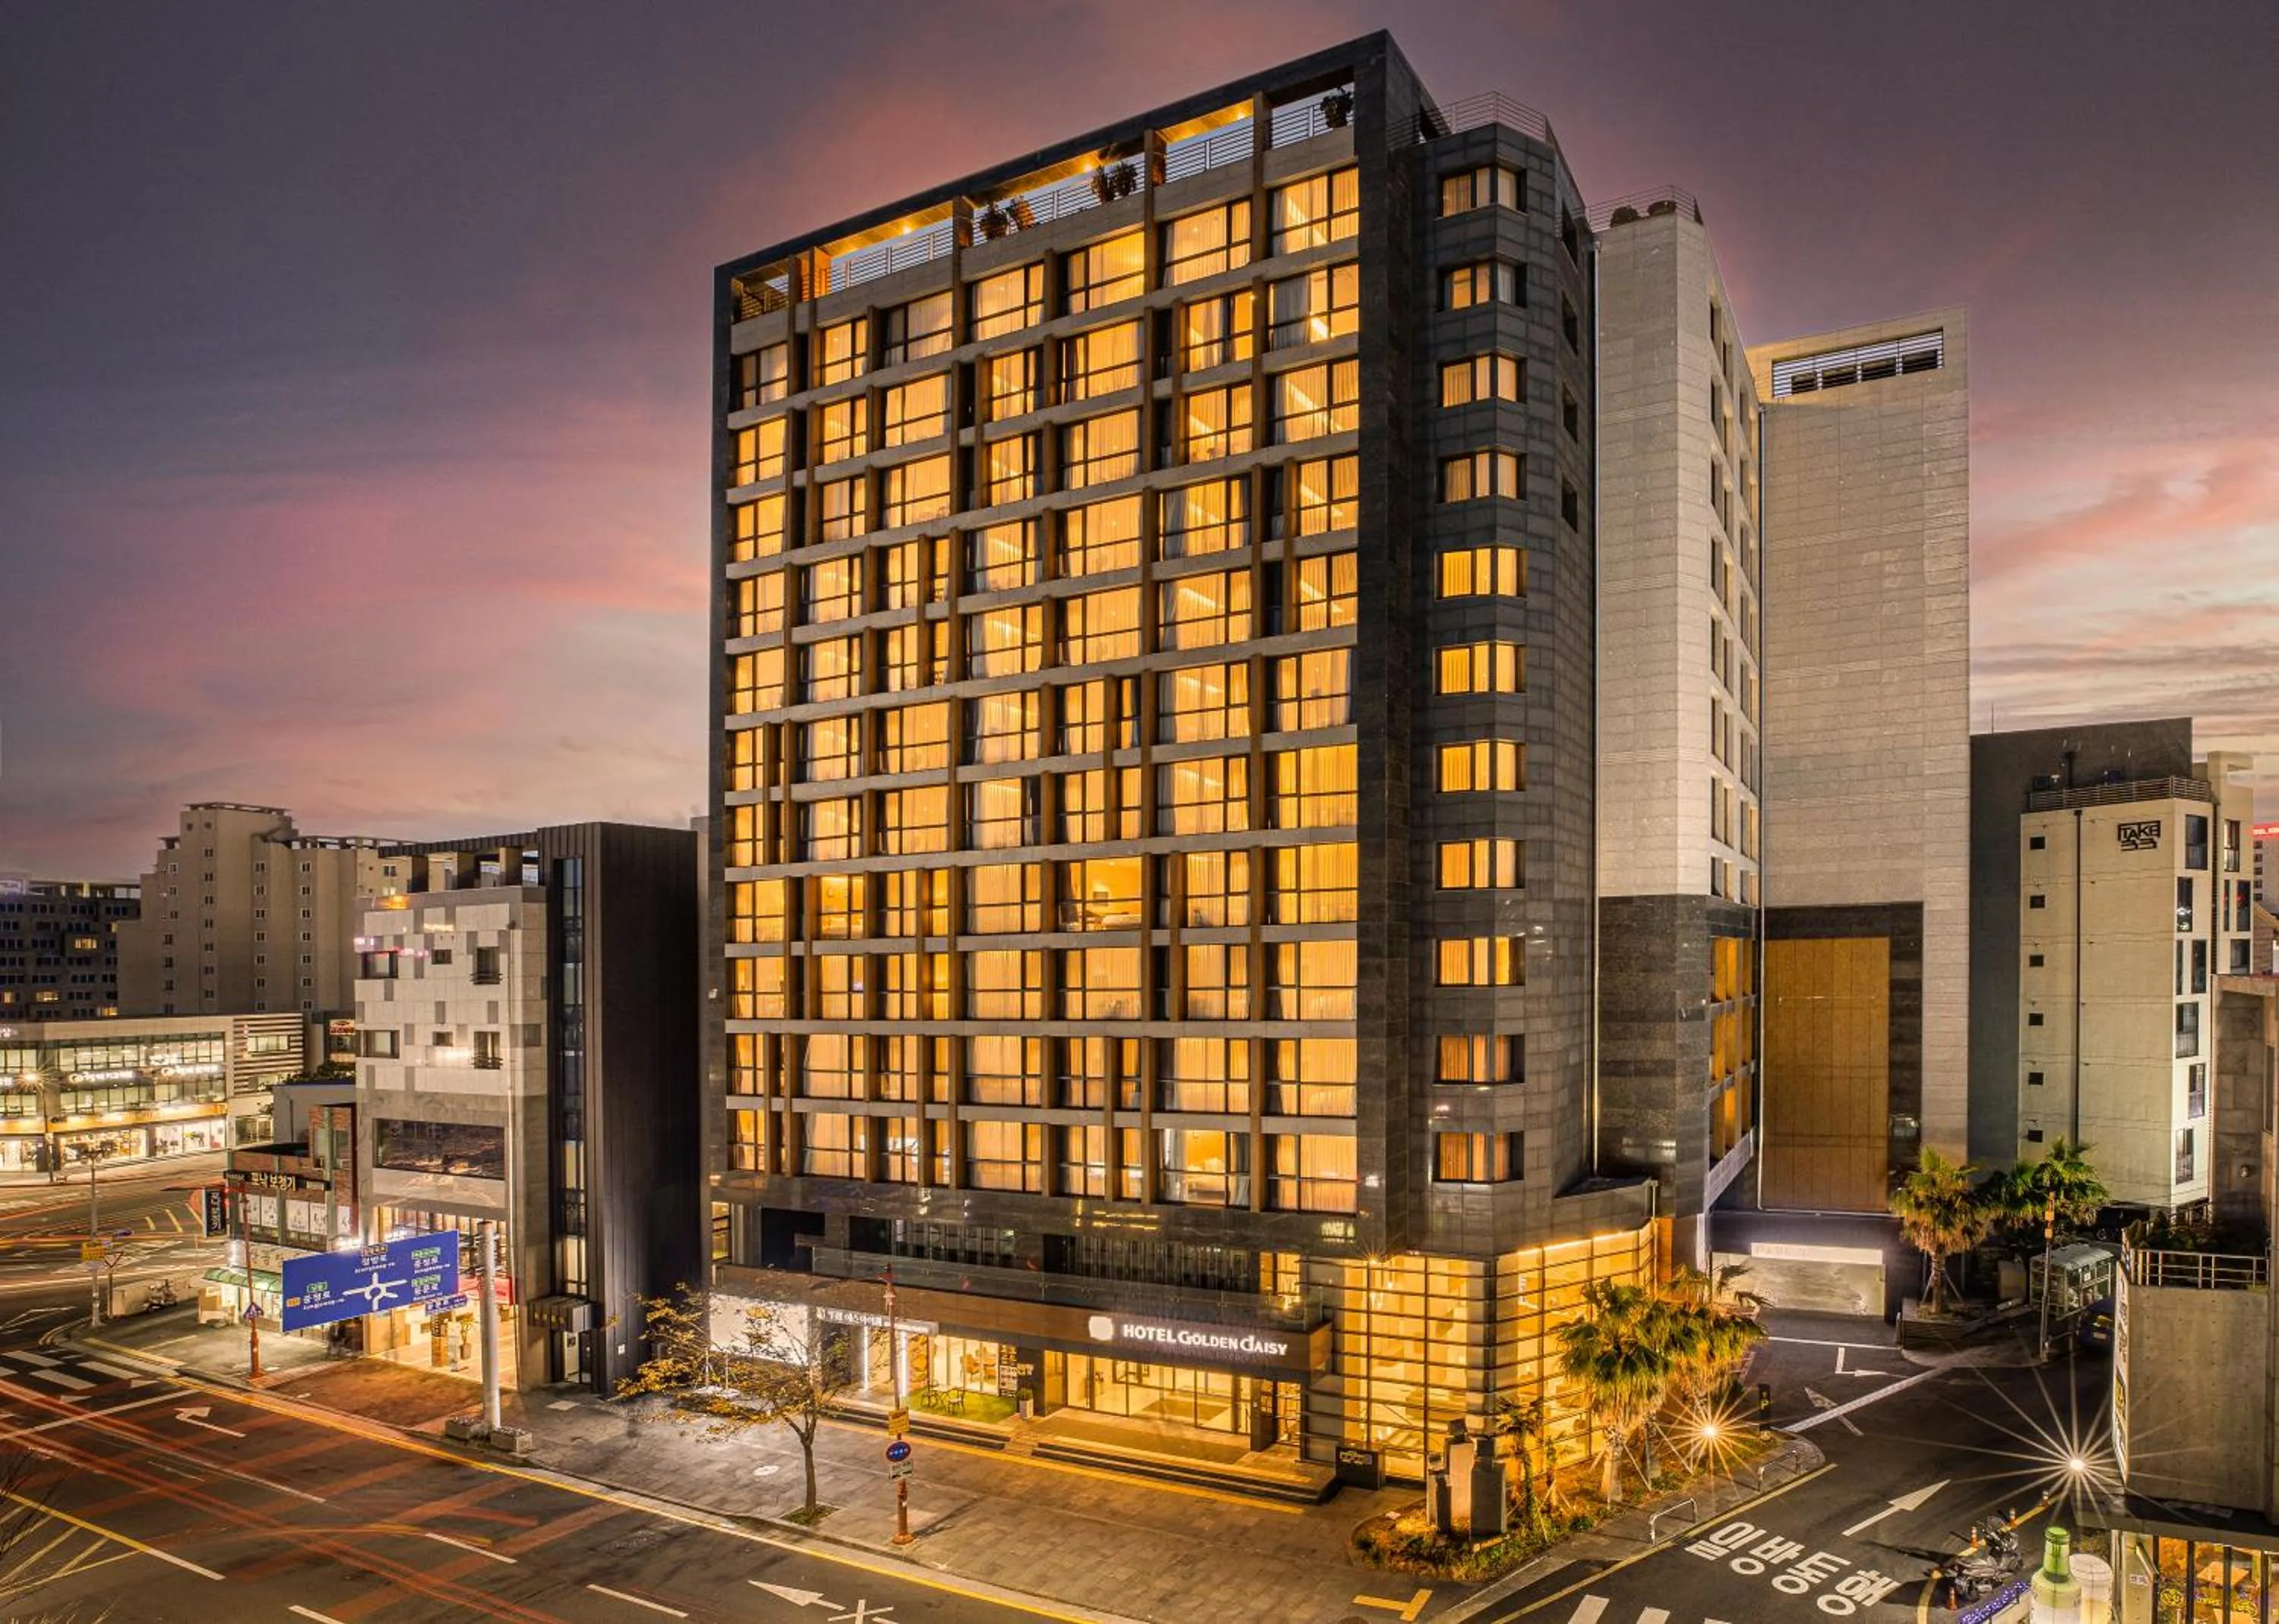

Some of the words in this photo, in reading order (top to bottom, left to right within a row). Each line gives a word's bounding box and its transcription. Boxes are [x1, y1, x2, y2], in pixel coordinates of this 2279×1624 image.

[2120, 823, 2158, 841] TAKE
[1123, 1324, 1177, 1343] HOTEL
[1178, 1331, 1238, 1350] GOLDEN
[1684, 1521, 1901, 1616] 일방통행
